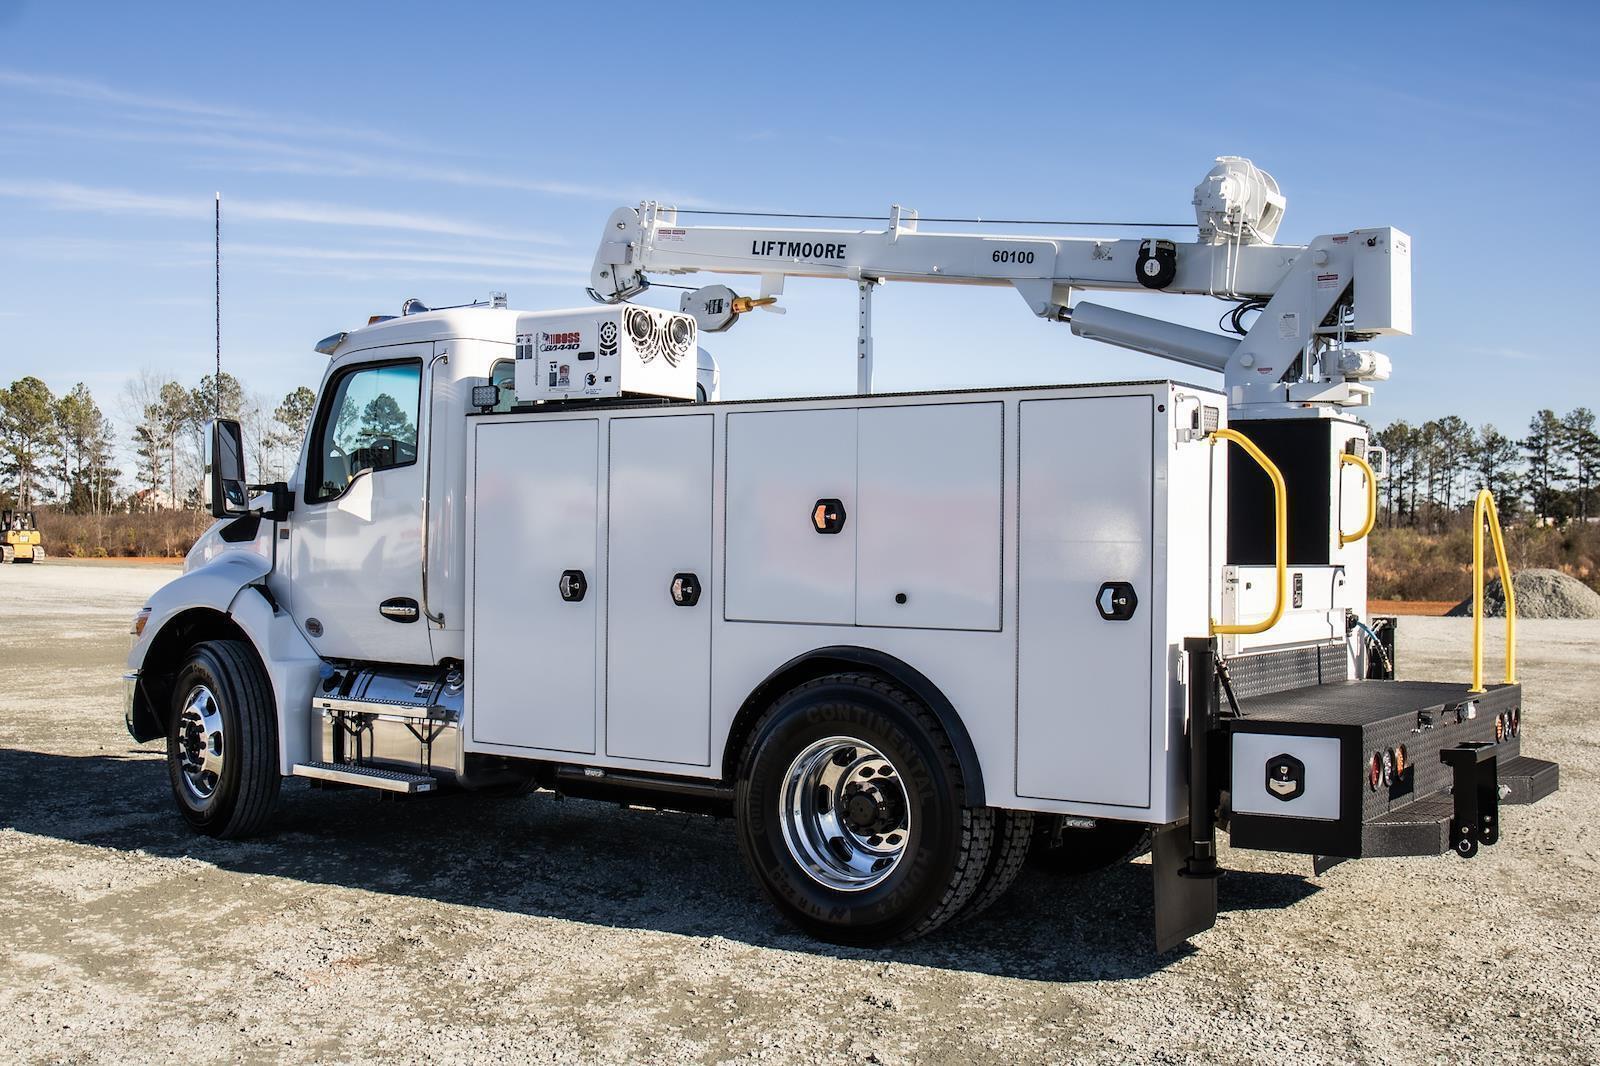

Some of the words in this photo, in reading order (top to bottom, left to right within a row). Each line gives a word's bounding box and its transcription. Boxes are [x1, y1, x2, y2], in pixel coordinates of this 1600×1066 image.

[751, 240, 847, 259] LIFTMOORE
[992, 250, 1034, 264] 60100
[554, 332, 580, 344] BOSS
[806, 703, 936, 805] CONTINENTAL
